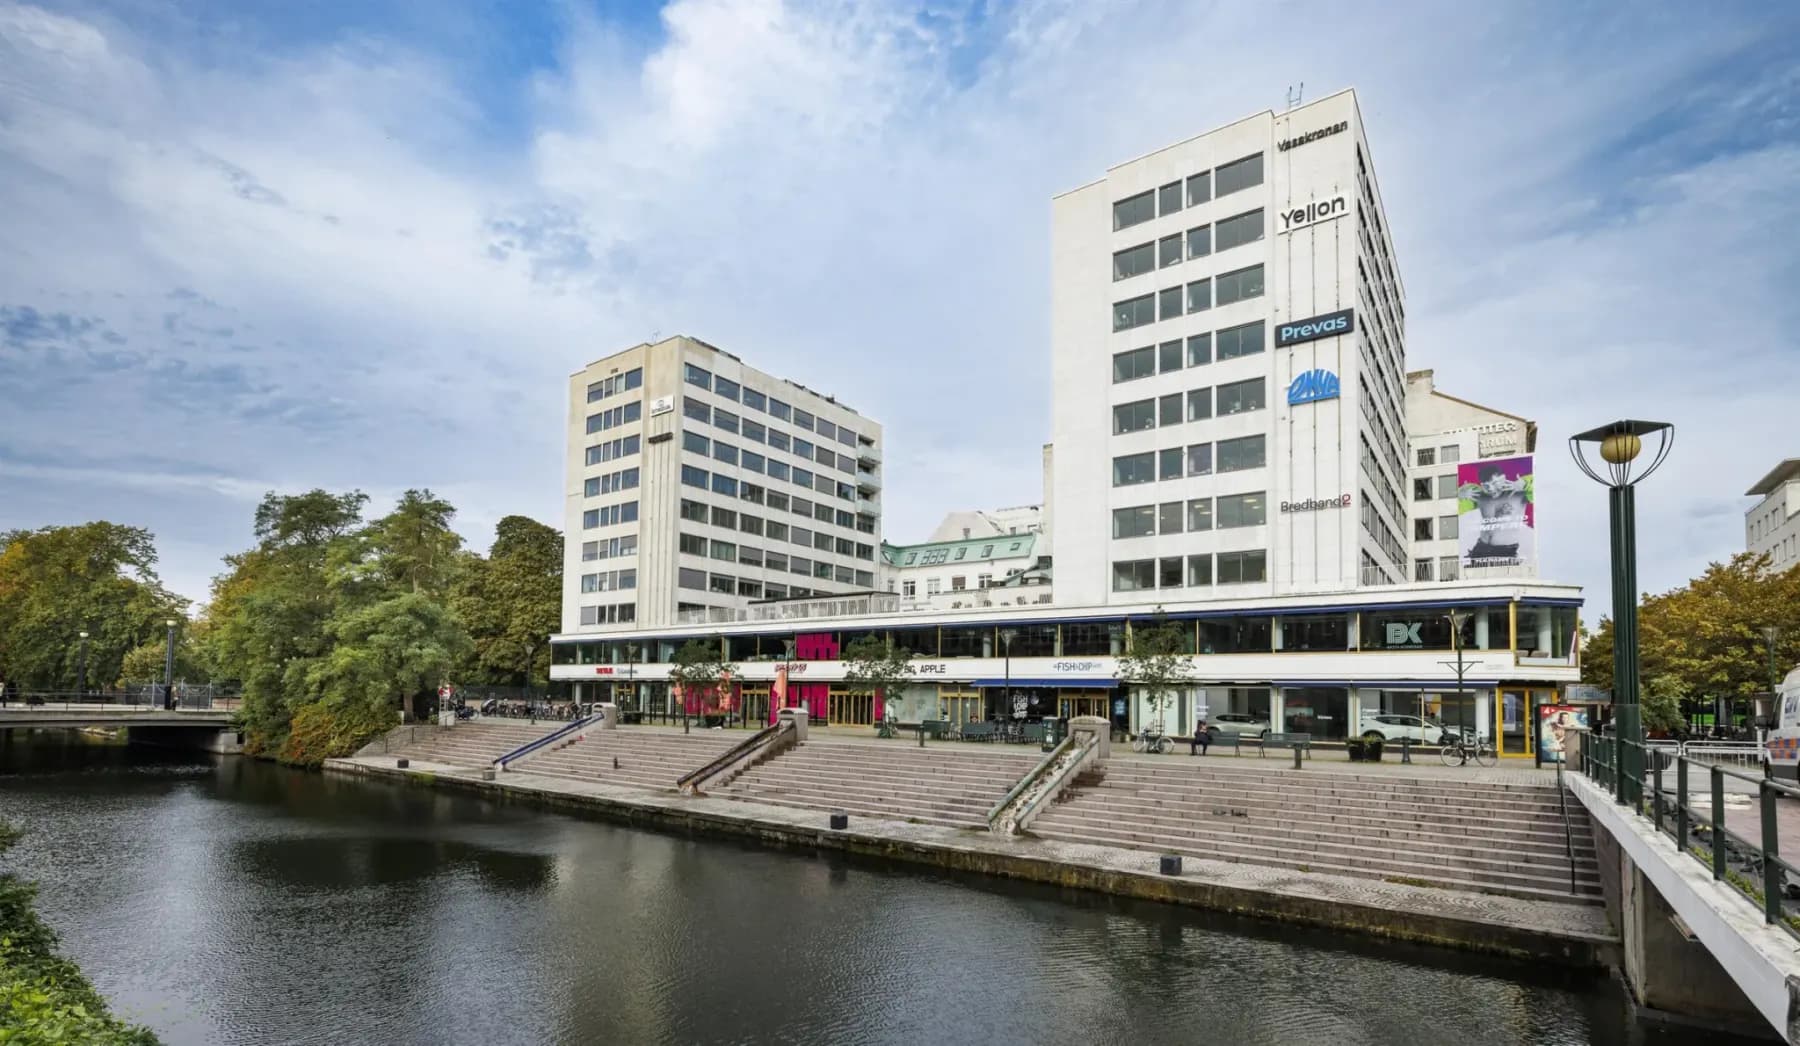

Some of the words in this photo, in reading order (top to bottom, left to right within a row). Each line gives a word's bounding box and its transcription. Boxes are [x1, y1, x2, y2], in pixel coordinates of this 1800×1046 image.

[1277, 120, 1348, 152] Vasakronan
[1280, 196, 1345, 229] Yellon
[1281, 315, 1347, 341] Prevas
[1280, 493, 1352, 513] Bredband2
[920, 664, 946, 674] APPLE
